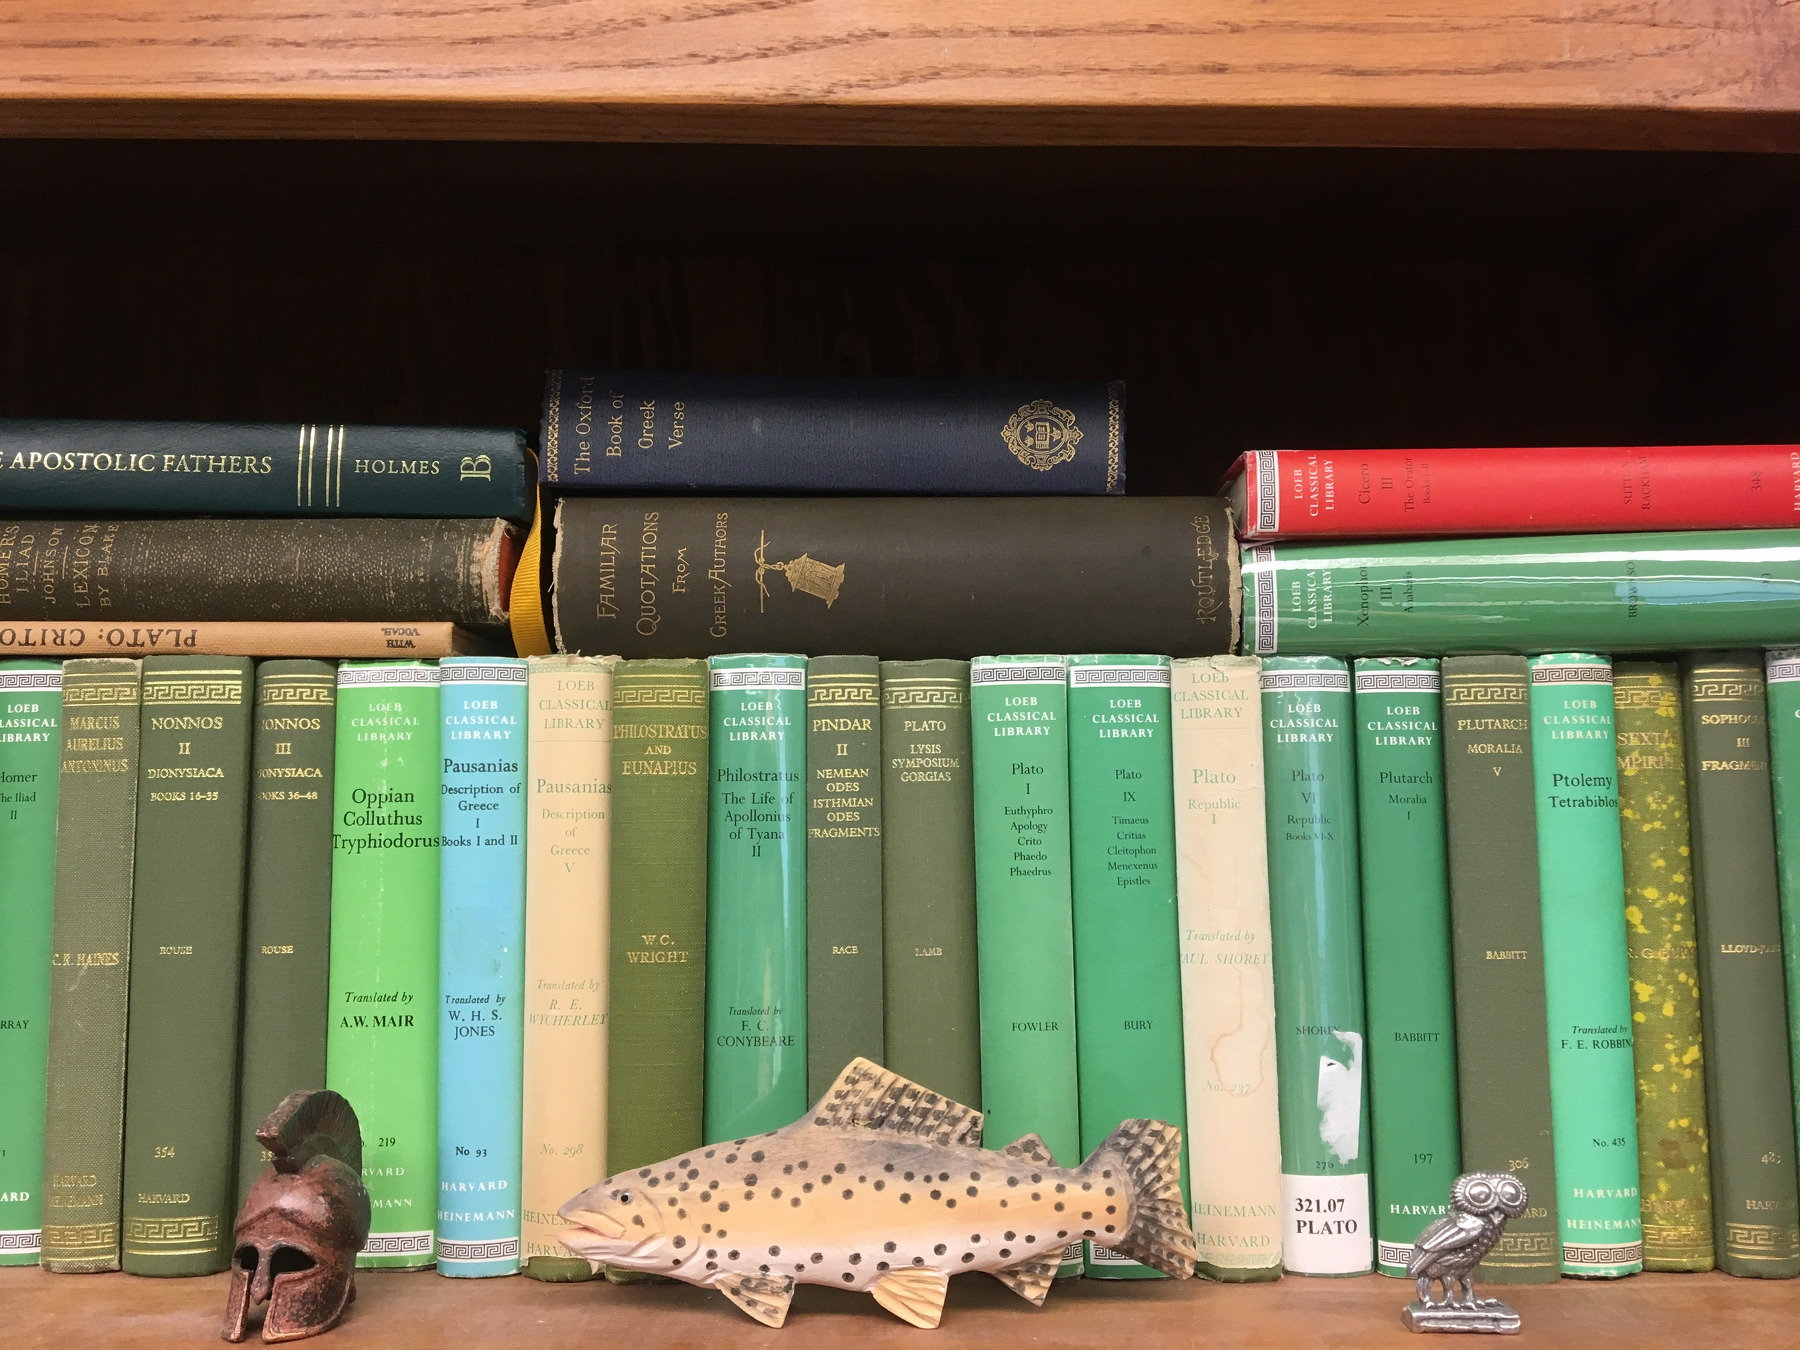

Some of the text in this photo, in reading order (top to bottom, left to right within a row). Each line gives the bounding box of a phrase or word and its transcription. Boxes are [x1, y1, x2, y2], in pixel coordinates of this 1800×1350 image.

[574, 376, 595, 476] The Oxford
[638, 399, 656, 450] Greek
[668, 401, 686, 450] Verse
[606, 415, 623, 457] Book
[10, 451, 156, 473] APOSTOLIC
[162, 454, 273, 476] FATHERS
[354, 459, 441, 476] HOLMES
[1293, 468, 1303, 500] LOEB
[1308, 454, 1319, 518] CLASSICAL
[1323, 459, 1335, 511] LIBRARY
[1358, 463, 1371, 505] Cicero
[1751, 471, 1763, 492] 348
[98, 523, 119, 577] BLAKE
[15, 534, 35, 593] ILIAD
[43, 527, 64, 604] JOHNSON
[73, 523, 99, 608] LEXICON
[1190, 514, 1223, 625] ROUTLEDGE
[596, 523, 622, 620] FAMILIAR
[636, 511, 662, 637] QUOTATIONS
[1291, 581, 1302, 612] LOEB
[1322, 569, 1333, 623] LIBRARY
[1381, 587, 1393, 601] III
[709, 585, 728, 638] GREEK
[0, 627, 198, 648] PLATO: CRITO
[386, 639, 416, 649] WITH
[557, 680, 596, 692] LOEB
[1004, 696, 1038, 707] LOEB
[1173, 689, 1249, 703] CLASSICAL
[7, 703, 40, 714] LOEB
[369, 702, 402, 713] LOEB
[463, 700, 499, 710] LOEB
[539, 699, 612, 712] CLASSICAL
[740, 701, 774, 712] LOEB
[1109, 698, 1142, 709] LOEB
[1288, 703, 1322, 713] LOEB
[1563, 700, 1598, 709] LOEB
[987, 711, 1057, 723] CLASSICAL
[1180, 707, 1244, 720] LIBRARY
[1386, 706, 1421, 716] LOEB
[152, 716, 224, 730] NONNOS
[351, 717, 420, 727] CLASSICAL
[445, 715, 518, 726] CLASSICAL
[543, 717, 606, 730] LIBRARY
[723, 716, 792, 727] CLASSICAL
[1092, 713, 1160, 725] CLASSICAL
[1270, 718, 1339, 728] CLASSICAL
[1457, 719, 1529, 731] PLUTARCH
[1543, 715, 1613, 725] CLASSICAL
[812, 719, 873, 732] PINDAR
[903, 720, 947, 732] PLATO
[994, 726, 1052, 737] LIBRARY
[1367, 721, 1438, 731] CLASSICAL
[357, 732, 413, 742] LIBRARY
[451, 730, 512, 740] LIBRARY
[613, 724, 708, 740] PHILOSTRATUS
[729, 731, 785, 742] LIBRARY
[1099, 728, 1155, 739] LIBRARY
[1277, 733, 1334, 743] LIBRARY
[1551, 730, 1610, 740] LIBRARY
[1375, 736, 1433, 746] LIBRARY
[644, 745, 672, 756] AND
[910, 743, 942, 755] LYSIS
[1467, 743, 1524, 754] MORALIA
[443, 758, 519, 773] Pausanias
[622, 760, 697, 776] EUNAPIUS
[891, 758, 960, 768] SYMPOSIUM
[1011, 762, 1045, 776] Plato
[148, 768, 225, 779] DIONYSIACA
[717, 768, 800, 784] Philostratus
[816, 768, 870, 779] NEMEAN
[900, 771, 952, 782] GORGIAS
[1115, 769, 1143, 781] Plato
[1192, 768, 1237, 785] Plato
[1292, 769, 1325, 782] Plato
[1379, 771, 1433, 784] Plutarch
[536, 778, 612, 795] Pausanias
[826, 782, 860, 793] ODES
[1552, 773, 1613, 791] Ptolemy
[441, 783, 504, 798] Description
[352, 788, 415, 809] Oppian
[722, 792, 776, 805] The Life
[812, 797, 874, 809] ISTHMIAN
[1187, 798, 1241, 811] Republic
[1388, 794, 1428, 804] Moralia
[1548, 796, 1619, 808] Tetrabiblos
[458, 800, 500, 812] Greece
[1004, 805, 1054, 819] Euthyphro
[343, 811, 423, 826] Colluthus
[541, 808, 605, 821] Description
[724, 809, 791, 826] Apollonius
[826, 811, 860, 823] ODES
[1111, 815, 1150, 826] Timaeus
[1010, 820, 1049, 834] Apology
[1287, 814, 1332, 828] Republic
[748, 827, 786, 843] Tyana
[808, 826, 881, 839] FRAGMENTS
[1116, 830, 1147, 841] Critias
[332, 834, 440, 855] Tryphiodorus
[441, 834, 505, 848] Books and
[1017, 835, 1043, 847] Crito
[550, 844, 591, 856] Greece
[1013, 850, 1048, 862] Phaedo
[1107, 845, 1157, 858] Cleitophon
[1009, 866, 1052, 878] Phaedrus
[1107, 861, 1159, 871] Menexenus
[1116, 876, 1151, 889] Epistles
[1186, 929, 1241, 942] Translated
[261, 945, 295, 954] ROUSE
[832, 945, 859, 955] RACE
[914, 947, 943, 957] LAMB
[1485, 950, 1529, 960] BABBITT
[626, 951, 689, 963] WRIGHT
[1215, 953, 1270, 965] SHOREY
[536, 979, 586, 991] Translated
[344, 991, 414, 1005] Translated by
[445, 993, 507, 1007] Translated by
[728, 1006, 770, 1017] Translated
[372, 1014, 415, 1028] MAIR
[528, 1012, 610, 1027] WYCHERLEY
[1123, 1019, 1154, 1031] BURY
[454, 1025, 496, 1041] JONES
[1012, 1021, 1059, 1033] FOWLER
[1295, 1025, 1341, 1036] SHOREY
[1572, 1025, 1618, 1035] Translated
[717, 1035, 796, 1048] CONYBEARE
[1394, 1032, 1440, 1043] BABBITT
[1231, 1084, 1251, 1096] 237
[378, 1136, 396, 1148] 219
[1592, 1137, 1626, 1148] No. 435
[154, 1146, 176, 1159] 354
[476, 1146, 489, 1159] 93
[562, 1143, 585, 1159] 298
[1413, 1153, 1434, 1165] 197
[1508, 1158, 1530, 1172] 306
[1315, 1160, 1335, 1171] 276
[442, 1180, 508, 1192] HARVARD
[138, 1193, 191, 1205] HARVARD
[1573, 1187, 1638, 1199] HARVARD
[1294, 1198, 1346, 1214] 321.07
[438, 1208, 516, 1223] HEINEMANN
[1296, 1219, 1358, 1235] PLATO
[1566, 1217, 1642, 1231] HEINEMANN
[1197, 1233, 1271, 1248] HARVARD
